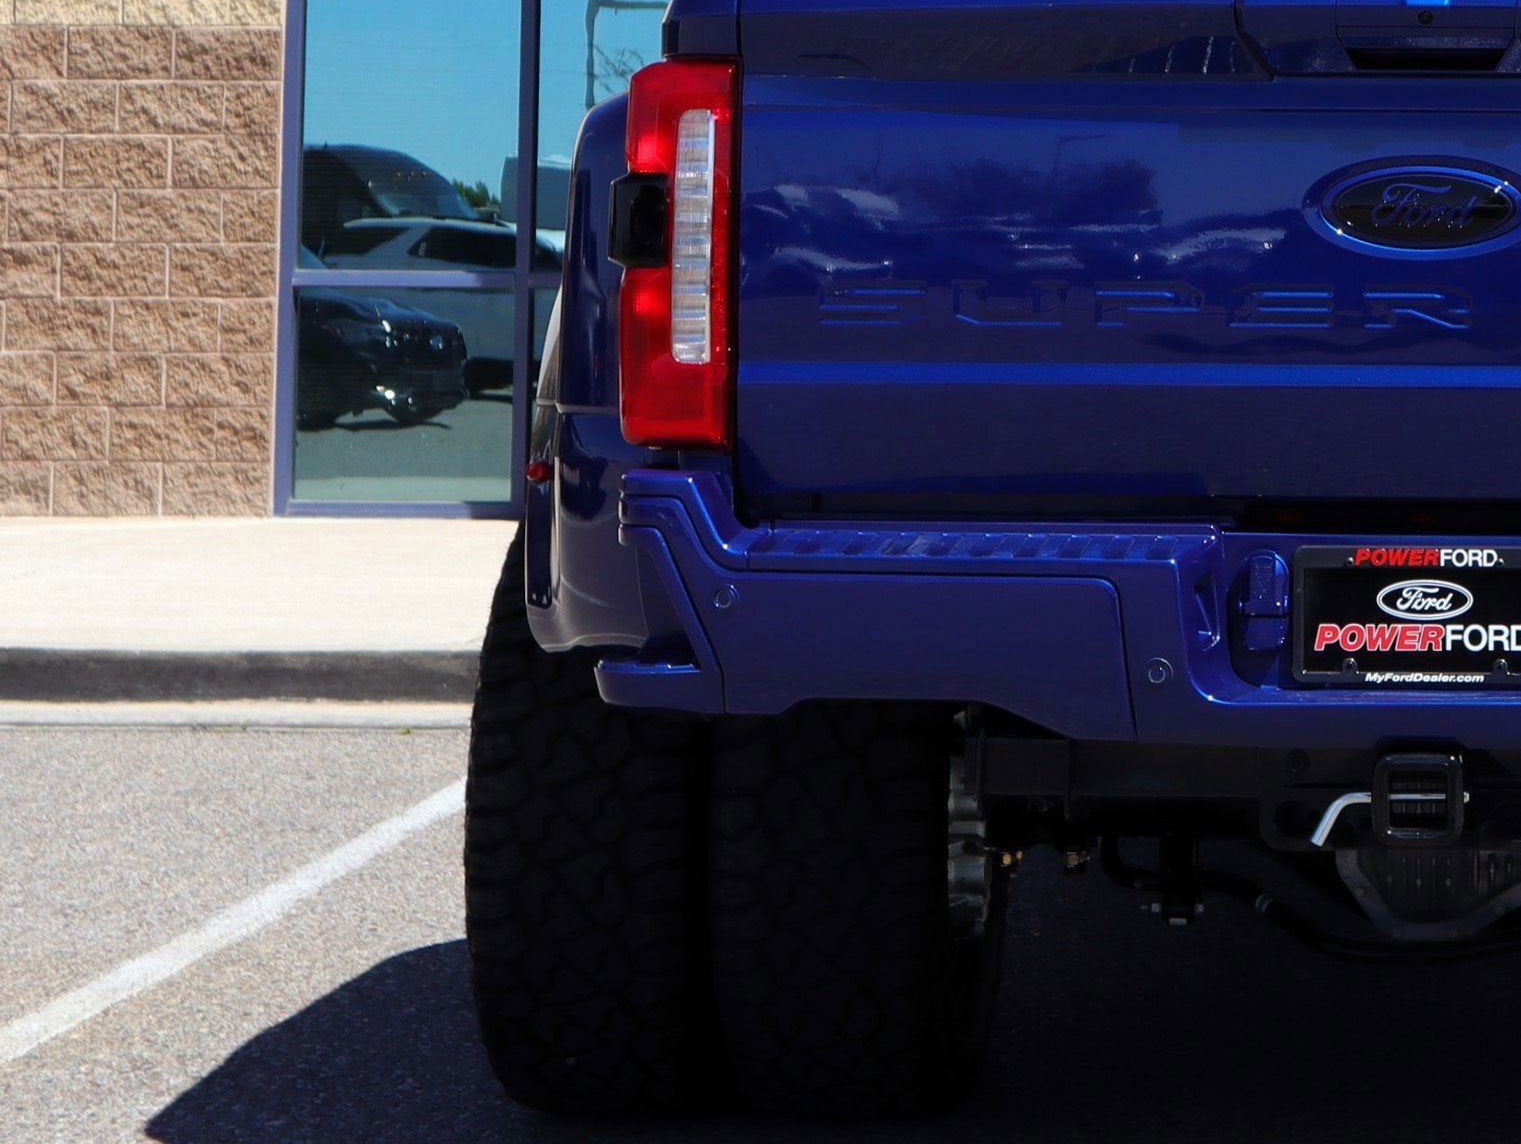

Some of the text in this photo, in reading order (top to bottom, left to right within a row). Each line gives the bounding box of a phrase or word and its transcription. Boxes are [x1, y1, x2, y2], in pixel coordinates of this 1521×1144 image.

[1371, 183, 1478, 228] Ford
[818, 279, 1472, 331] SUPER
[1396, 587, 1453, 611] Ford
[1365, 672, 1484, 683] MyFordDealer.com
